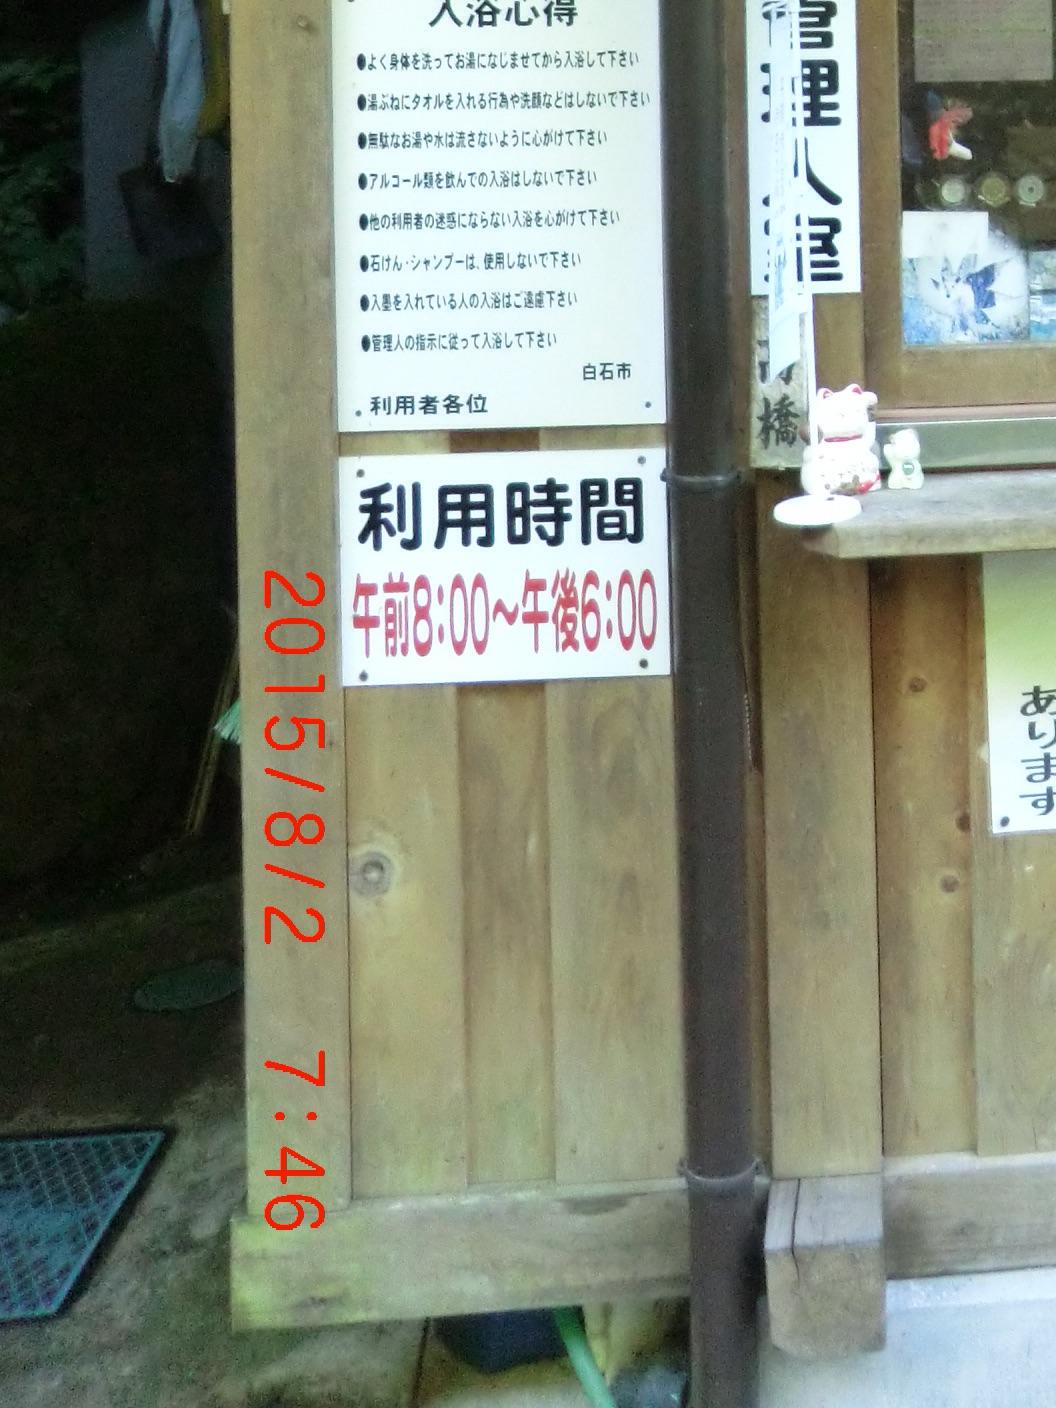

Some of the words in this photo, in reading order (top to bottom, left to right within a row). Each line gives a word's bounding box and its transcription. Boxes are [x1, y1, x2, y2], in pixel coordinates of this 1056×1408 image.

[367, 50, 640, 71] よく身体を洗ってお湯になじませてから入浴して下さい
[369, 169, 597, 191] アルコール類を飲んでの入浴はしないで下さい
[371, 331, 557, 353] 管理人の指示に従って入浴して下さい
[582, 362, 632, 381] 白石市
[370, 393, 489, 416] 利用者各位
[357, 476, 644, 551] 利用時間
